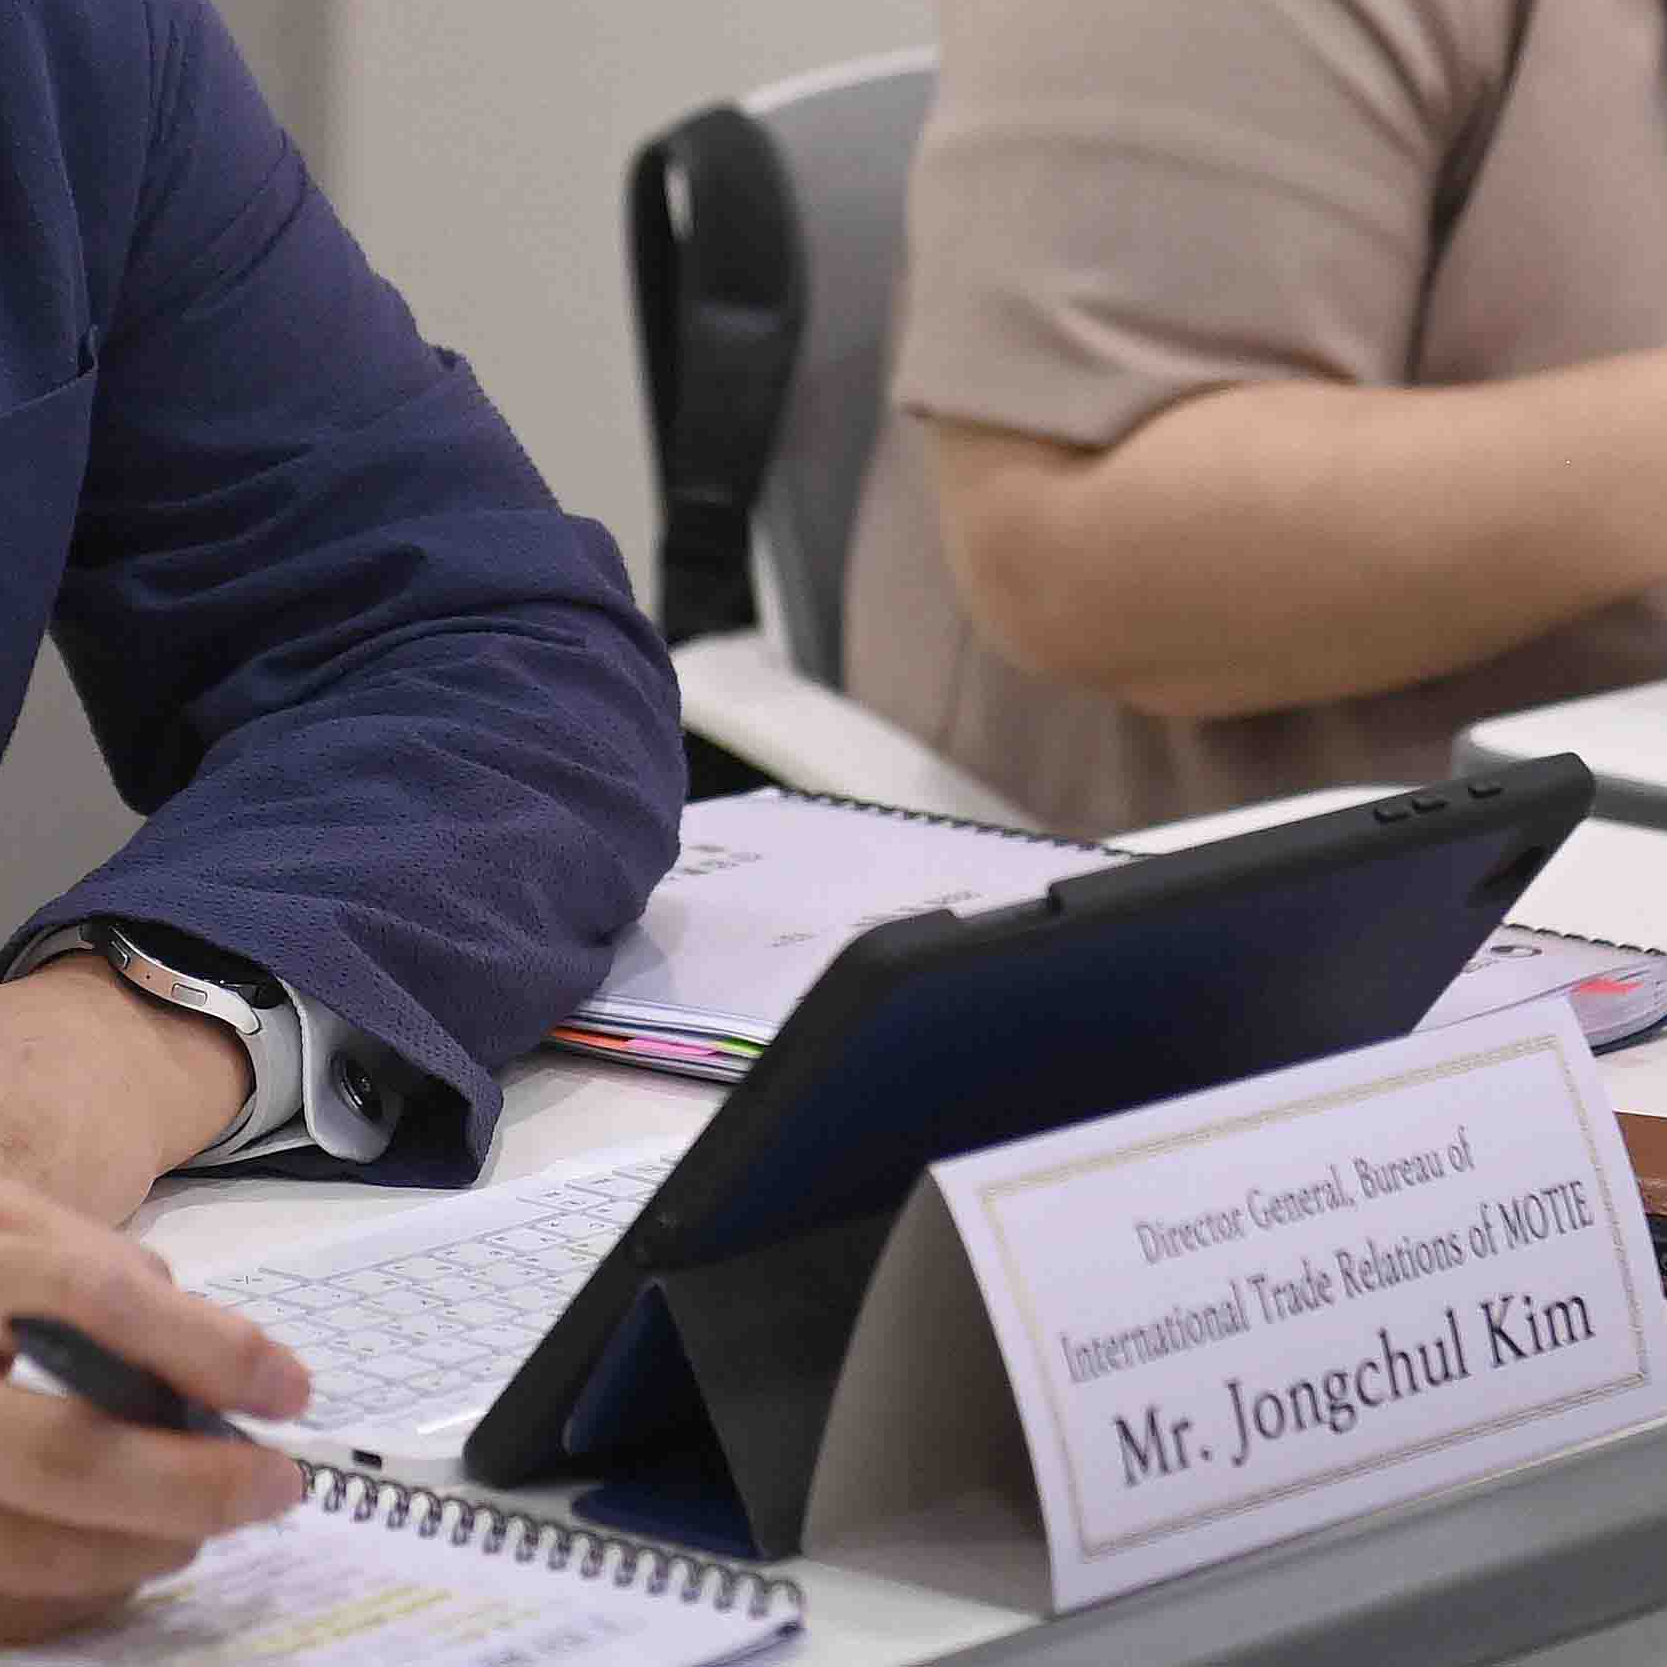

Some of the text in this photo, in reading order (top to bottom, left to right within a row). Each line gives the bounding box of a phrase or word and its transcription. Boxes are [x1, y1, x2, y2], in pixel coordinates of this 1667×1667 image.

[1061, 1179, 1595, 1384] International Trade Relations of MOTIE
[1136, 1125, 1477, 1265] Director General, Bureau of
[1113, 1291, 1596, 1487] Mr. Jongchul Kim
